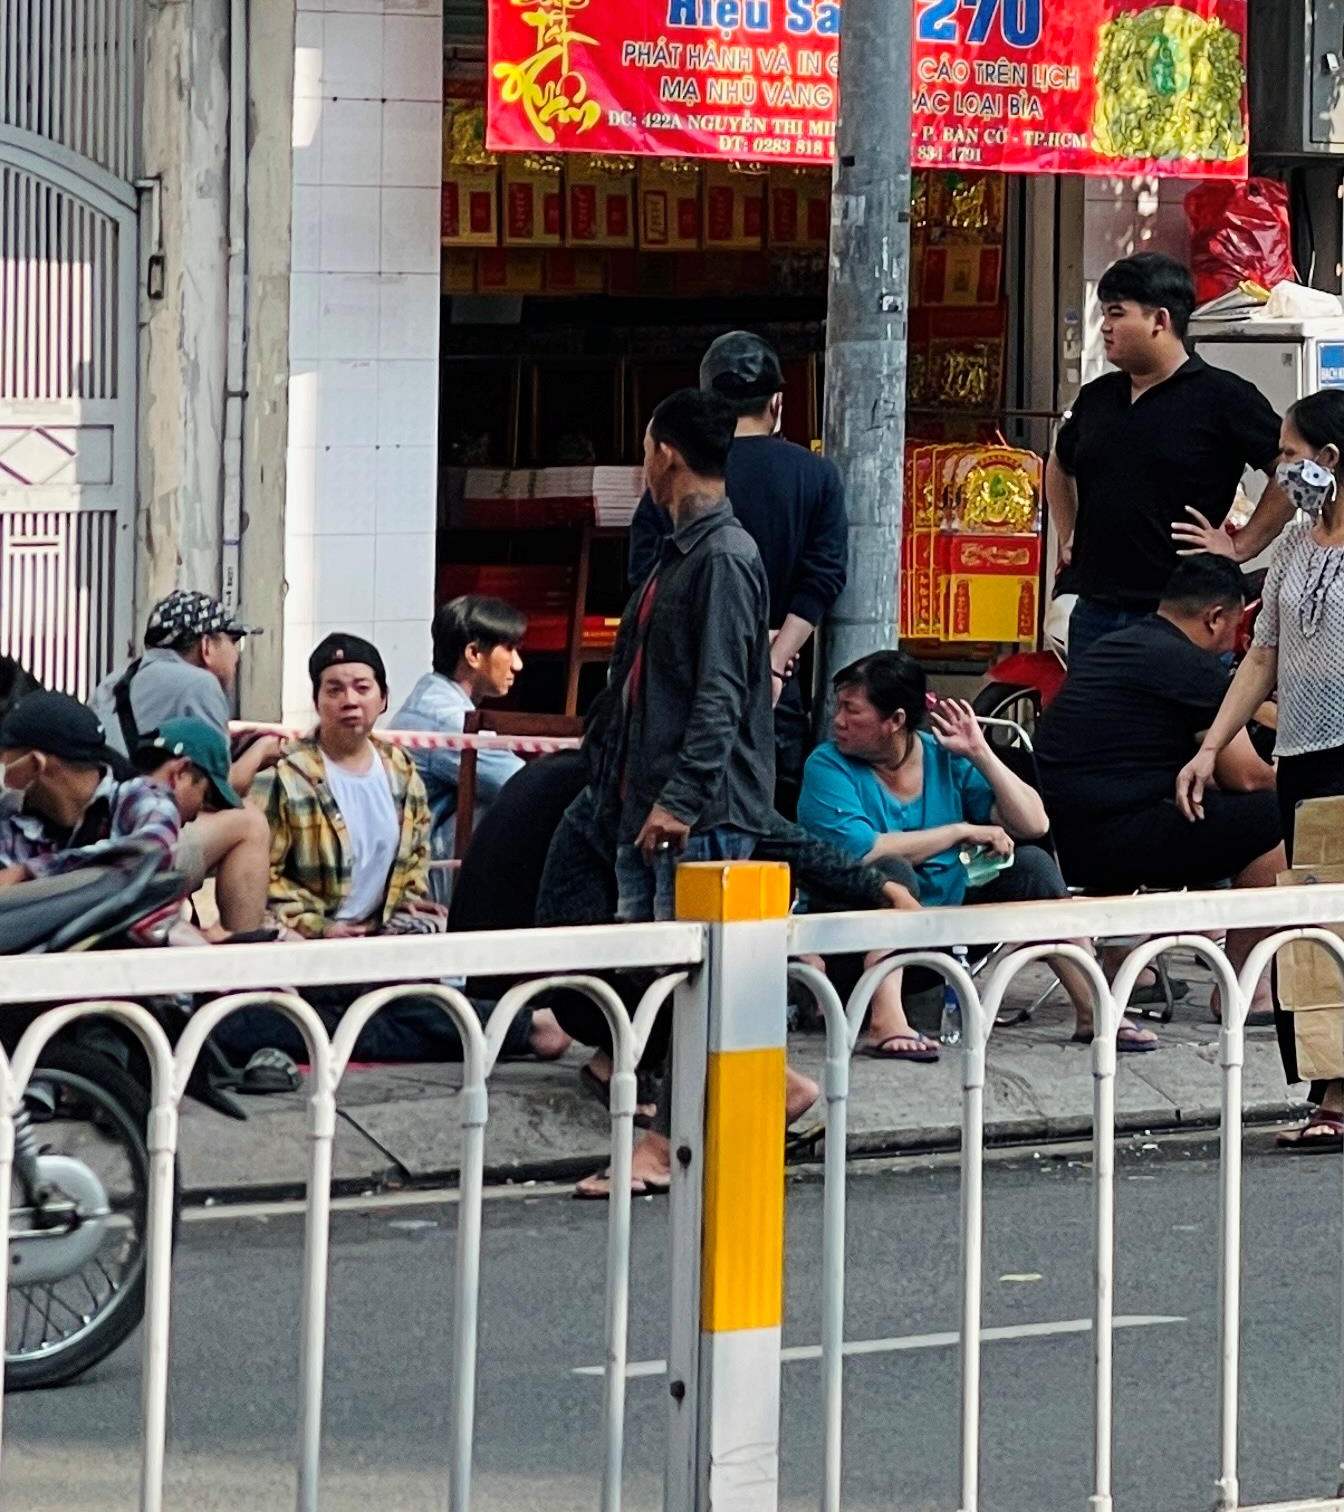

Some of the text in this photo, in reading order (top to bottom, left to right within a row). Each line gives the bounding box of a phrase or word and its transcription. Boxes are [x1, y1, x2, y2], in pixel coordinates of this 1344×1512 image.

[621, 36, 683, 69] PHÁT
[686, 39, 753, 74] HÀNH
[758, 42, 795, 76] VÀ
[798, 50, 823, 76] IN
[917, 51, 970, 85] CÁO
[974, 56, 1028, 88] TRÊN
[1032, 62, 1080, 93] LỊCH
[641, 112, 683, 130] 422A
[659, 76, 700, 106] MẠ
[762, 75, 834, 110] VÀNG
[953, 90, 1004, 121] LOẠI
[1007, 88, 1044, 121] BÌA
